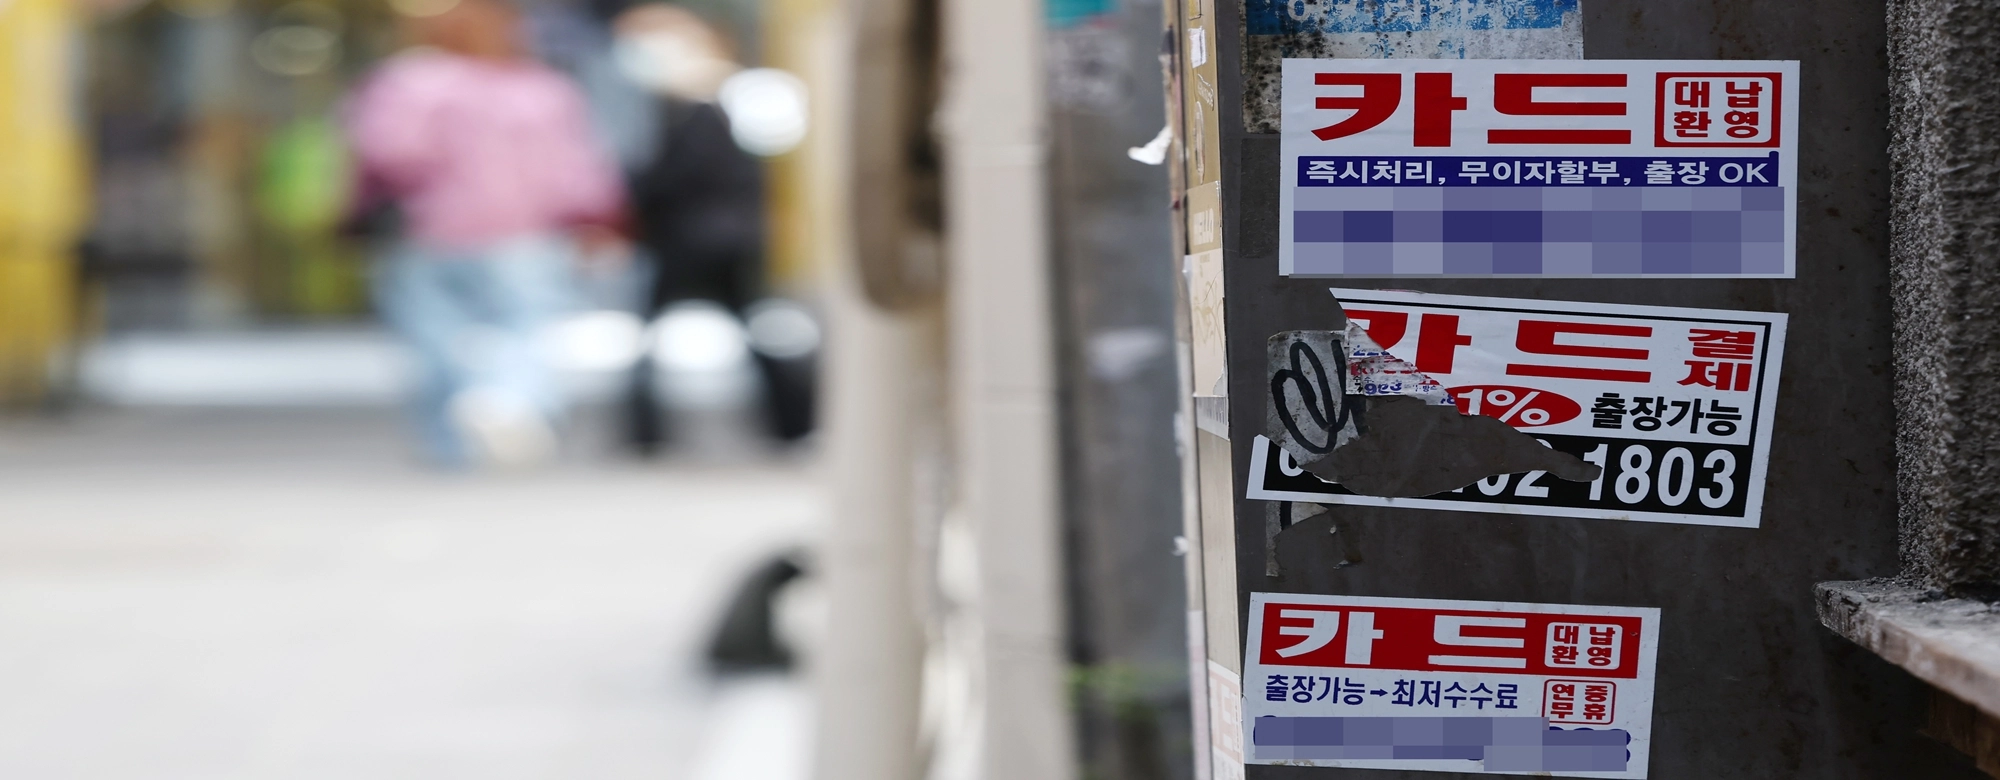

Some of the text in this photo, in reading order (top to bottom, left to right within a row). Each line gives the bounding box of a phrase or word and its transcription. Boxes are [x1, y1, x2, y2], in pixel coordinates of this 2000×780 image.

[1310, 72, 1632, 147] 카드
[1306, 160, 1770, 186] 즉시처리, 무이자할부, 출장 OK
[1457, 388, 1550, 427] 1%
[1591, 392, 1743, 436] 출장가능
[1583, 443, 1738, 509] 1803
[1275, 609, 1527, 669] 카드
[1265, 675, 1519, 709] 출장가능 최저수수료
